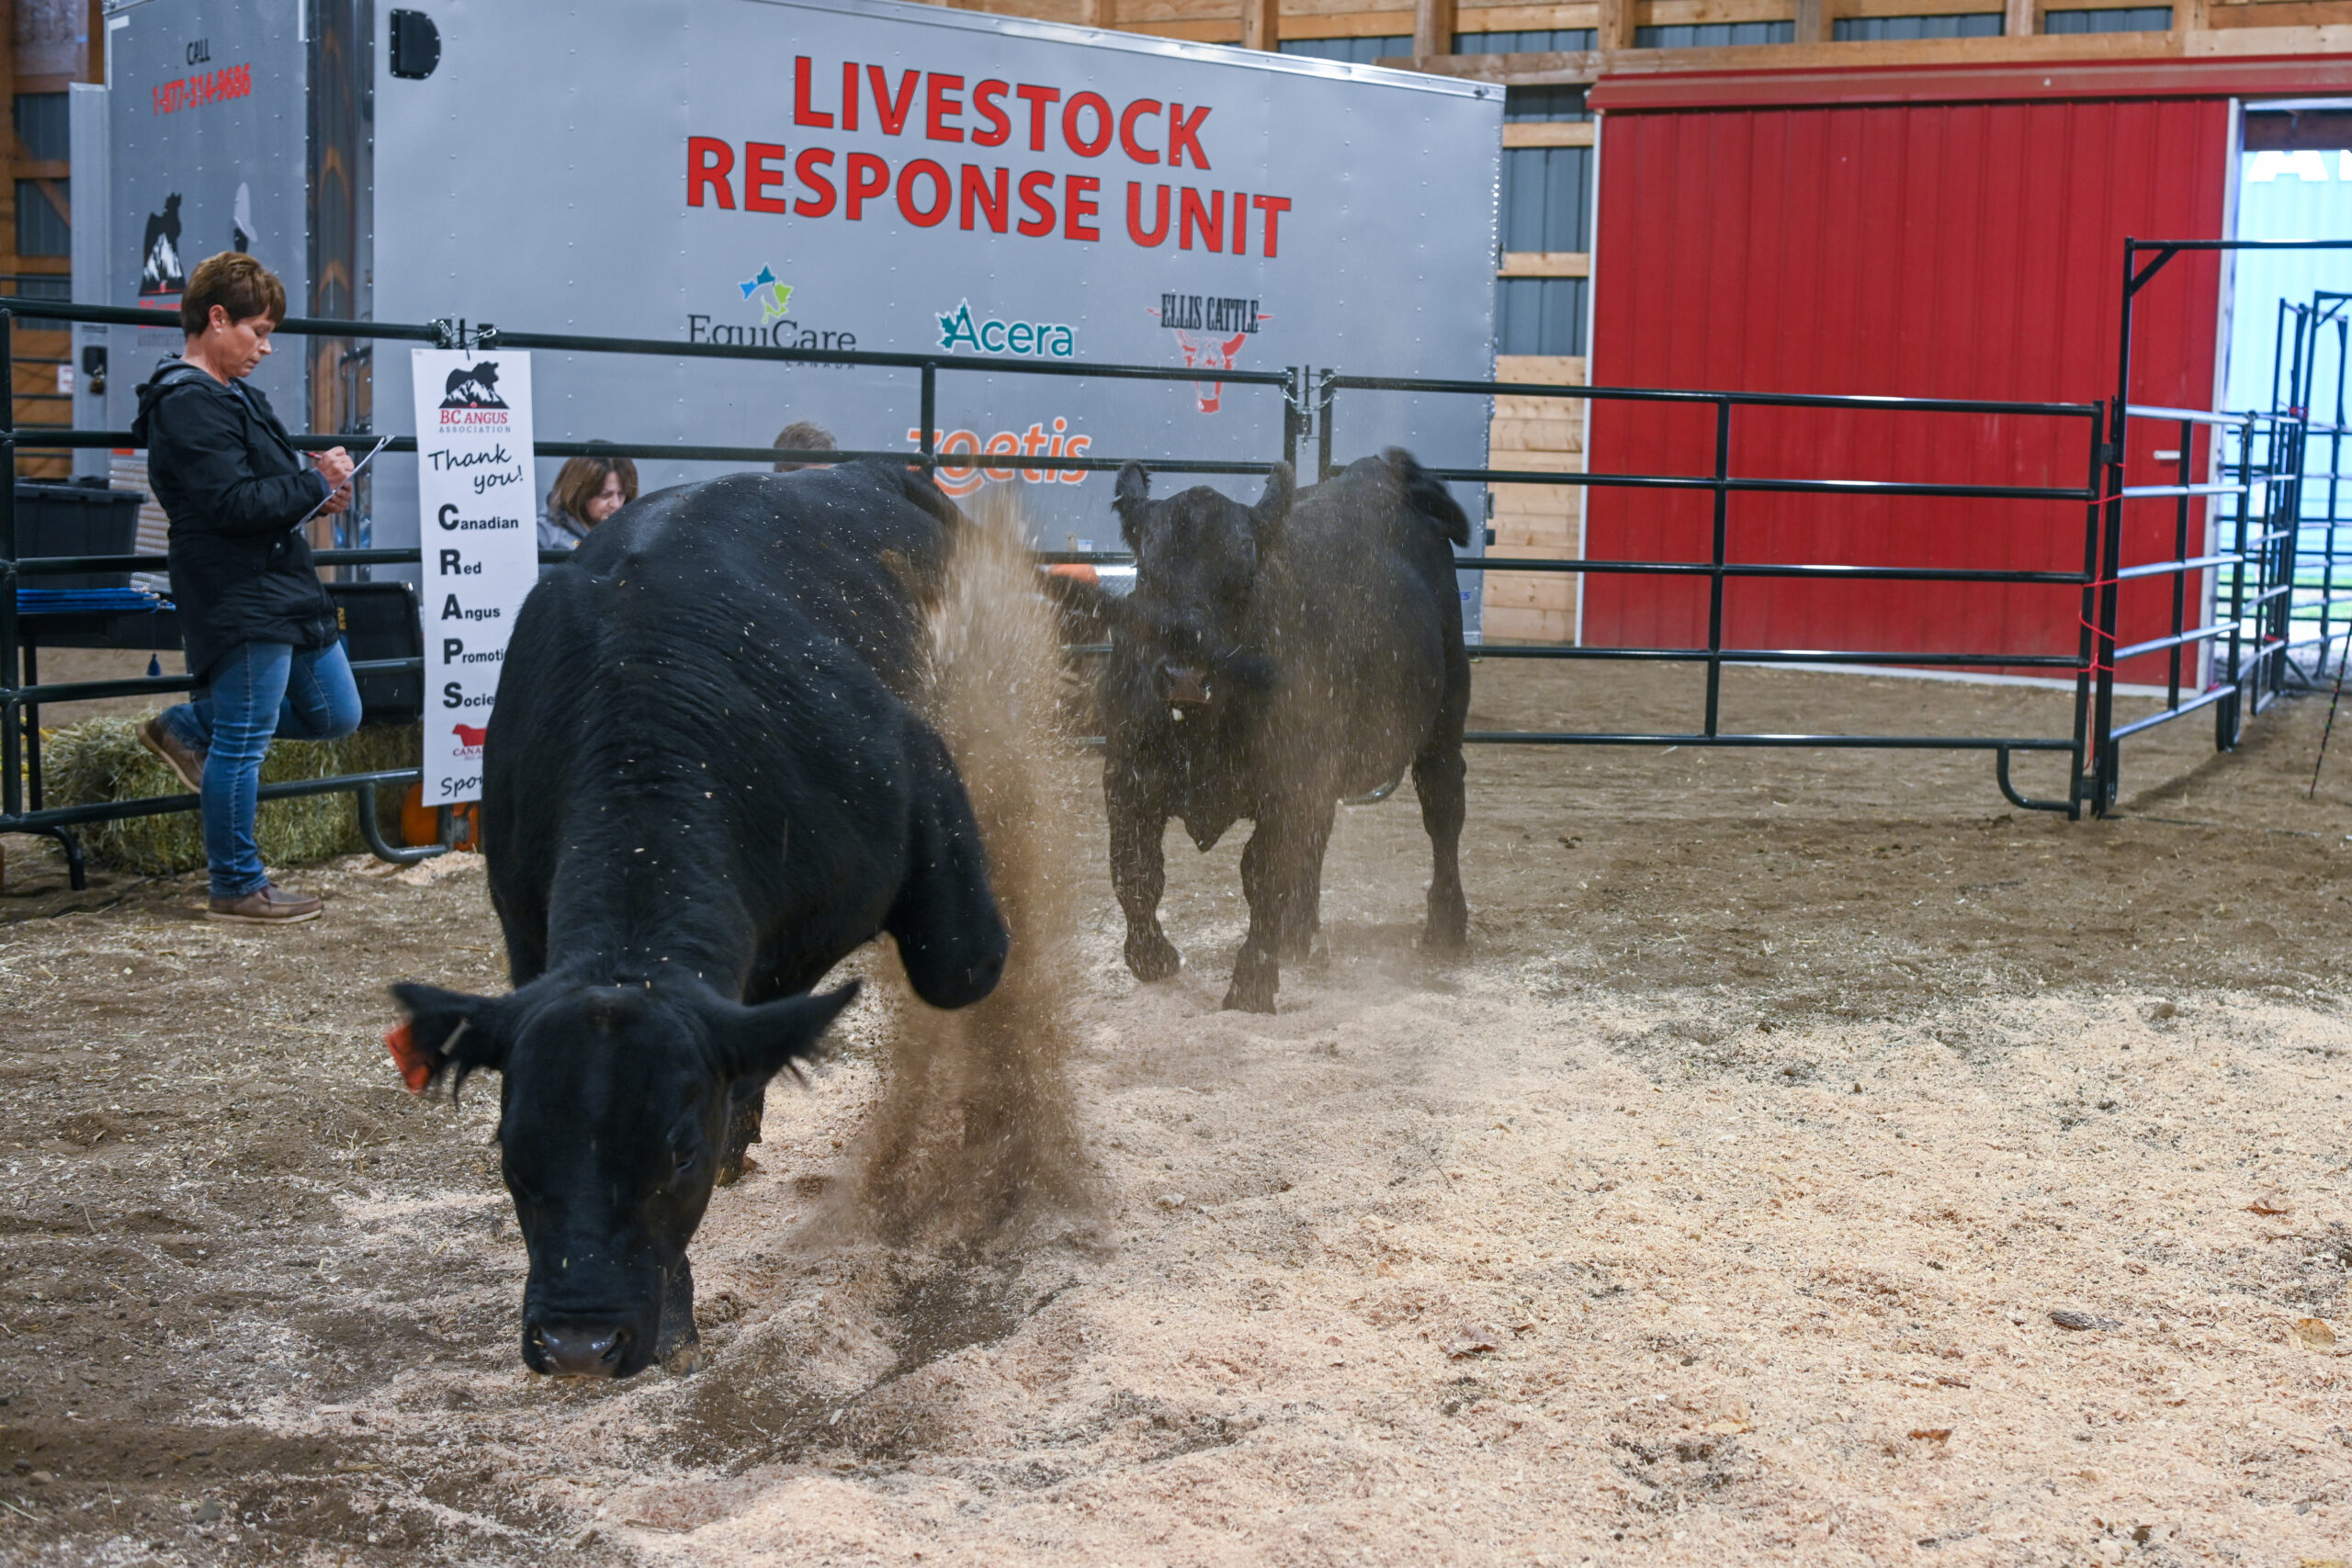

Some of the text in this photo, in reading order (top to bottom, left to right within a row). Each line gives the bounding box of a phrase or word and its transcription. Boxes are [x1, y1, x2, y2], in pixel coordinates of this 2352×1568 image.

[187, 38, 210, 66] CALL
[794, 55, 1213, 172] LIVESTOCK
[686, 136, 1293, 259] RESPONSE UNIT
[1161, 293, 1259, 333] ELLIS CATTLE
[687, 314, 856, 351] EquiCare
[940, 302, 1074, 356] Acera
[439, 425, 511, 434] ASSOCIATION
[440, 410, 508, 424] BC ANGUS
[428, 443, 512, 470] Thank
[474, 465, 524, 494] you!
[438, 503, 519, 531] Canadian
[440, 548, 482, 575] Red
[441, 593, 501, 621] Angus
[453, 746, 483, 757] CANA
